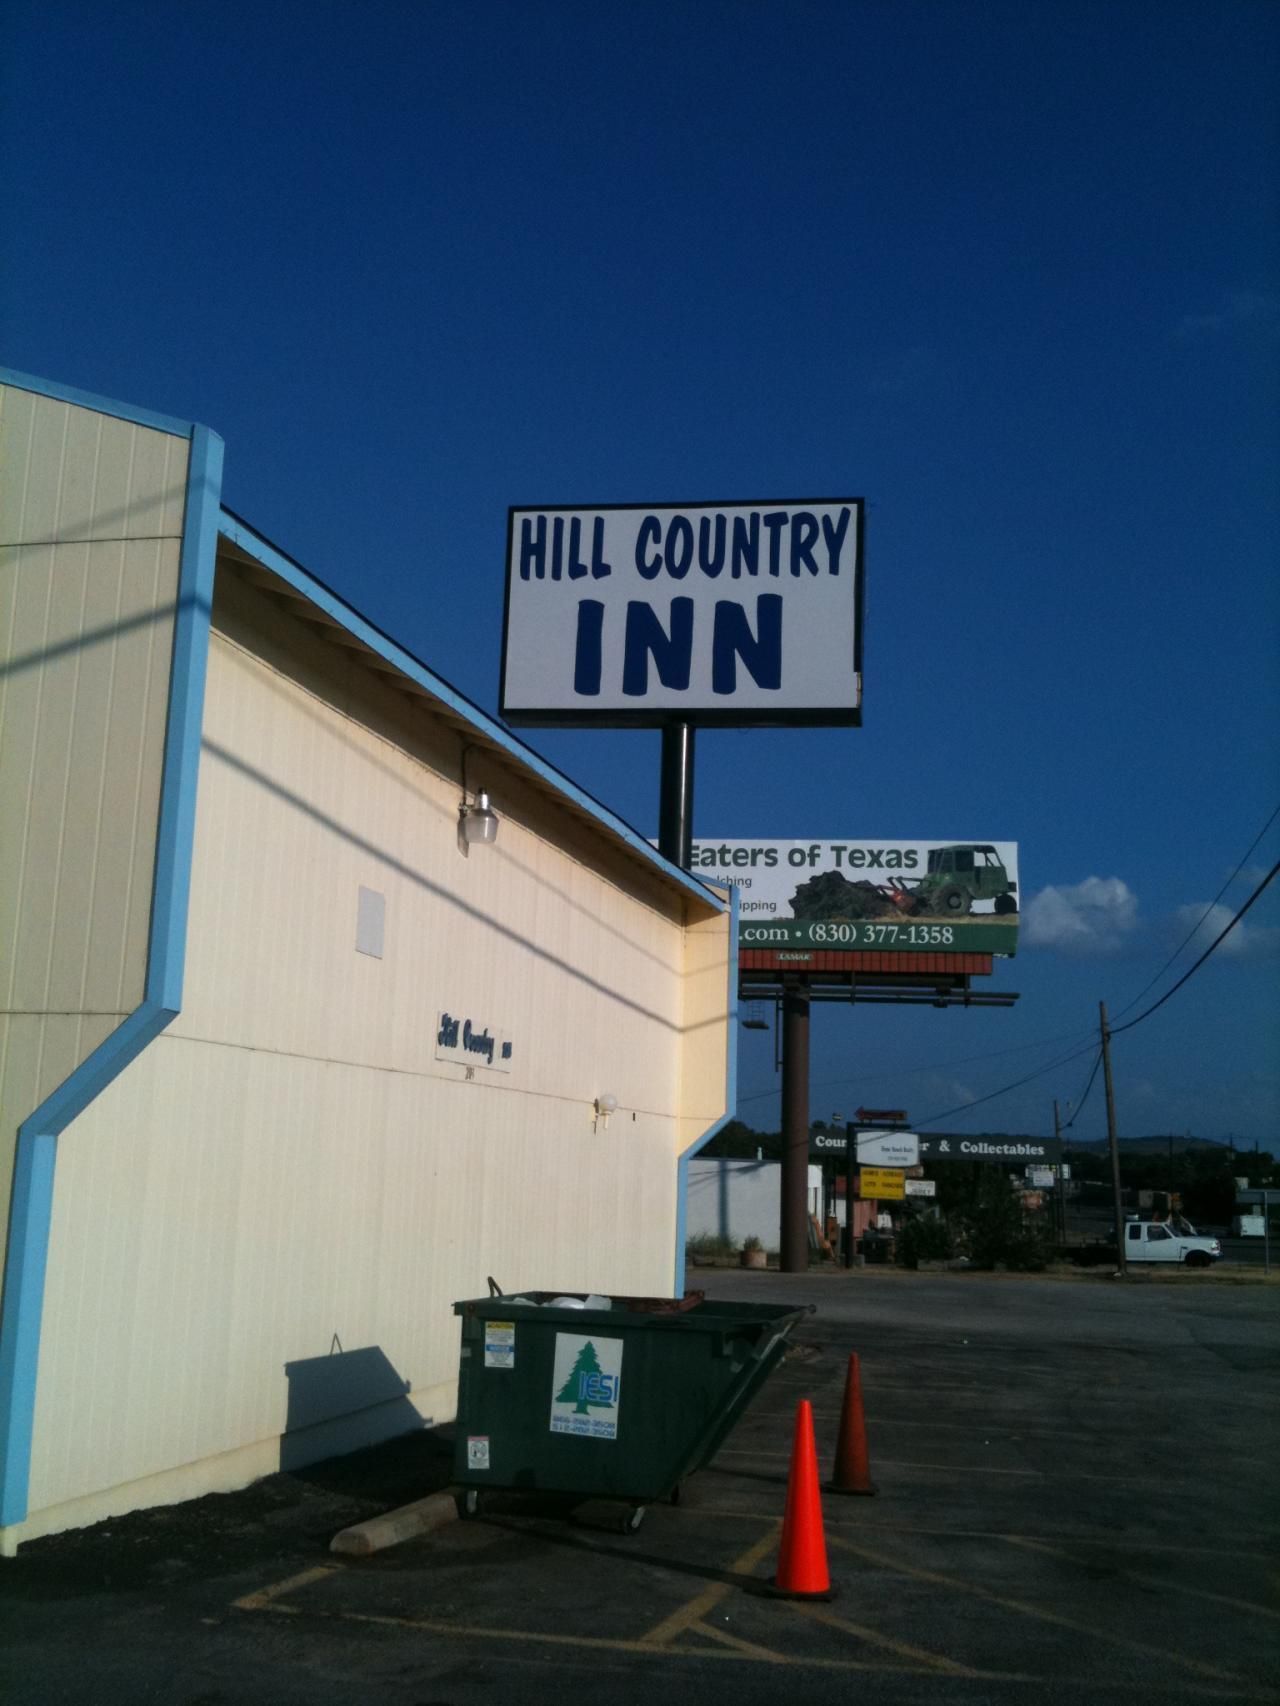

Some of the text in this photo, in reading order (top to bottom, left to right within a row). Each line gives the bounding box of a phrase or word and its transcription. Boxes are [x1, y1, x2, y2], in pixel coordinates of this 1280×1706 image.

[519, 506, 851, 581] HILL COUNTRY
[573, 593, 783, 697] INN
[787, 844, 821, 868] of
[830, 845, 918, 869] Texas
[808, 923, 857, 942] (830)
[863, 925, 954, 944] 377-1358
[939, 1139, 951, 1153] &
[960, 1141, 1045, 1156] Collectables
